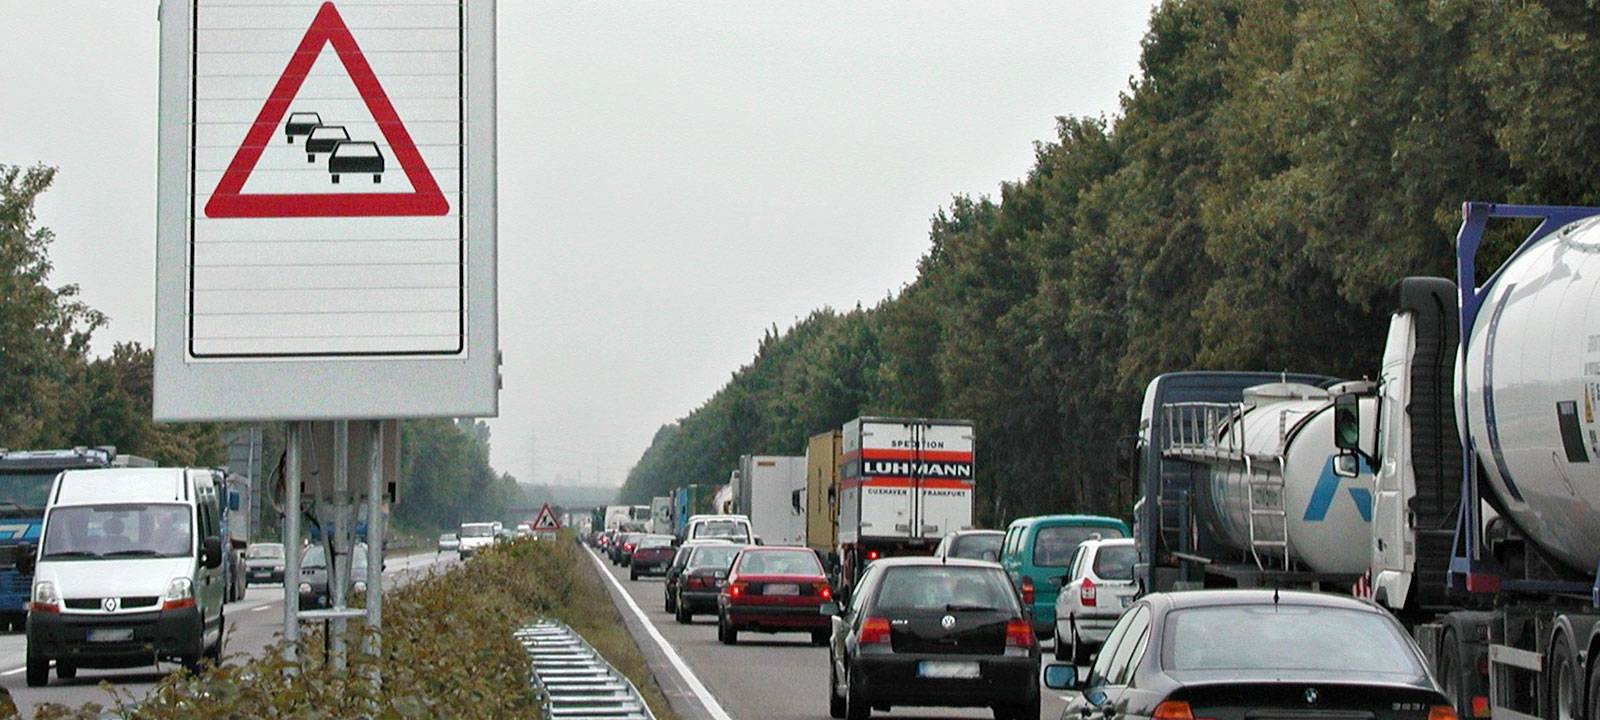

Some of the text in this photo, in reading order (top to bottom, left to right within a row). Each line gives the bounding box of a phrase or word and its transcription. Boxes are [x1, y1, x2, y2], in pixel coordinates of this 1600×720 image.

[864, 461, 971, 476] LUHMANN
[867, 488, 966, 498] CUXHAVEN FRANKFURT
